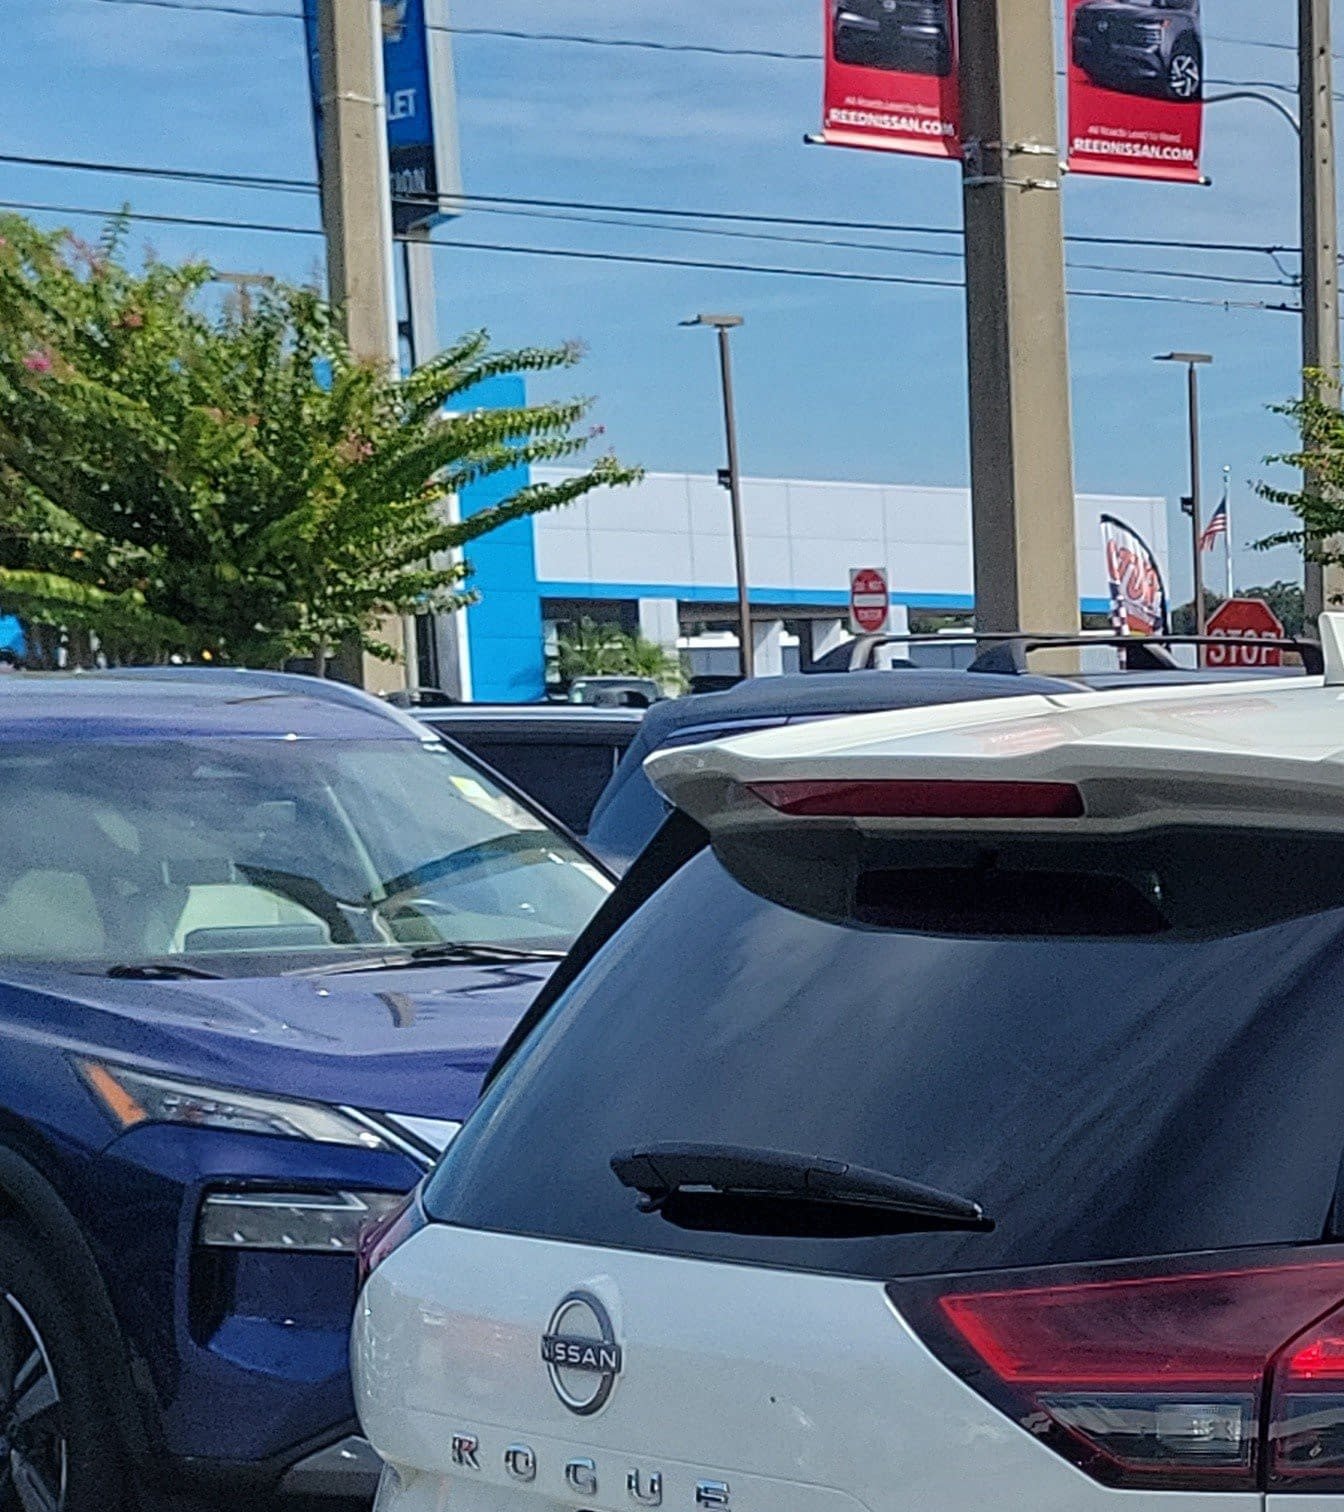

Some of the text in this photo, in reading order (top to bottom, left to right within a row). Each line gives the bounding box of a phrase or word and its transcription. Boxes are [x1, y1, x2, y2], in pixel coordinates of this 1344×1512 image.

[829, 108, 955, 136] REEDNISSAN.COM
[1073, 138, 1194, 160] REEDNISSAN.COM
[1209, 629, 1278, 665] STOP
